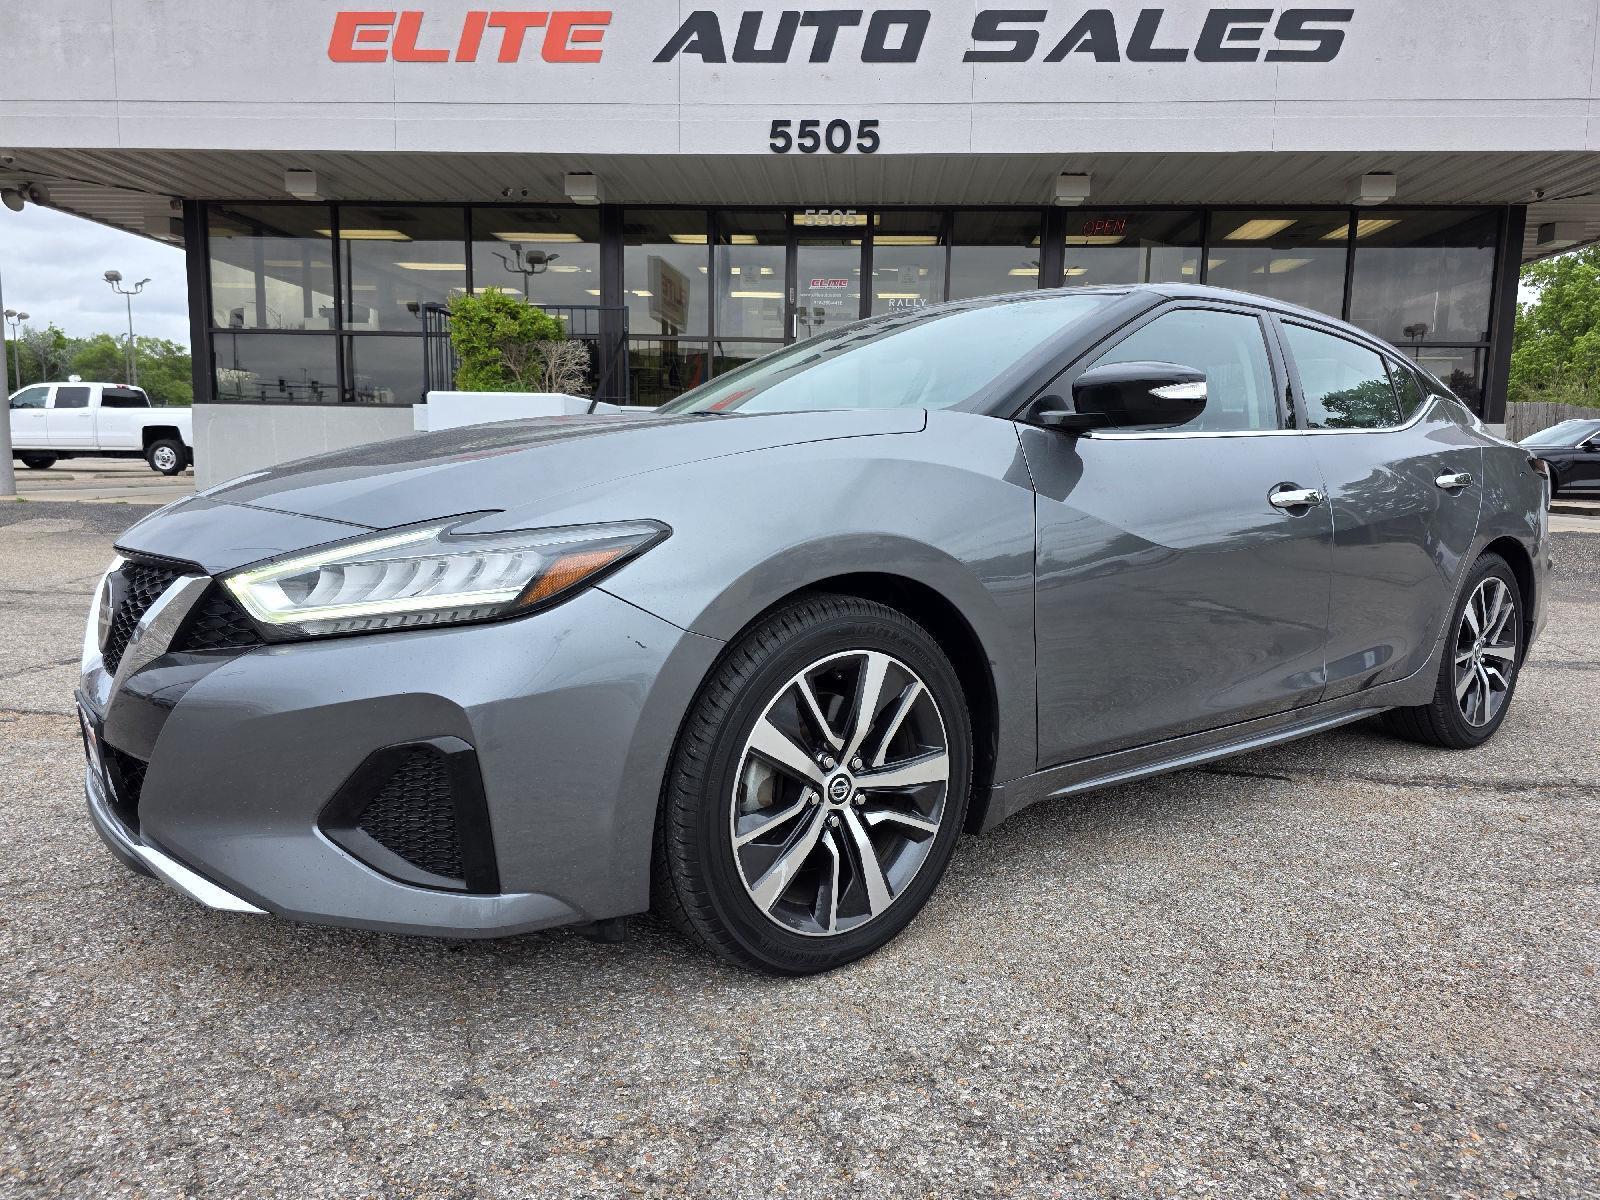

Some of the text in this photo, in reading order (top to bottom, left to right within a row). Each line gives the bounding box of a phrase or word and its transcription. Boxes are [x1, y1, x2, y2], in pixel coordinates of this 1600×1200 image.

[328, 8, 1354, 63] ELITE AUTO SALES
[768, 119, 880, 154] 5505
[804, 209, 857, 227] 5505
[1083, 219, 1126, 236] OPEN
[888, 299, 927, 308] RALLY
